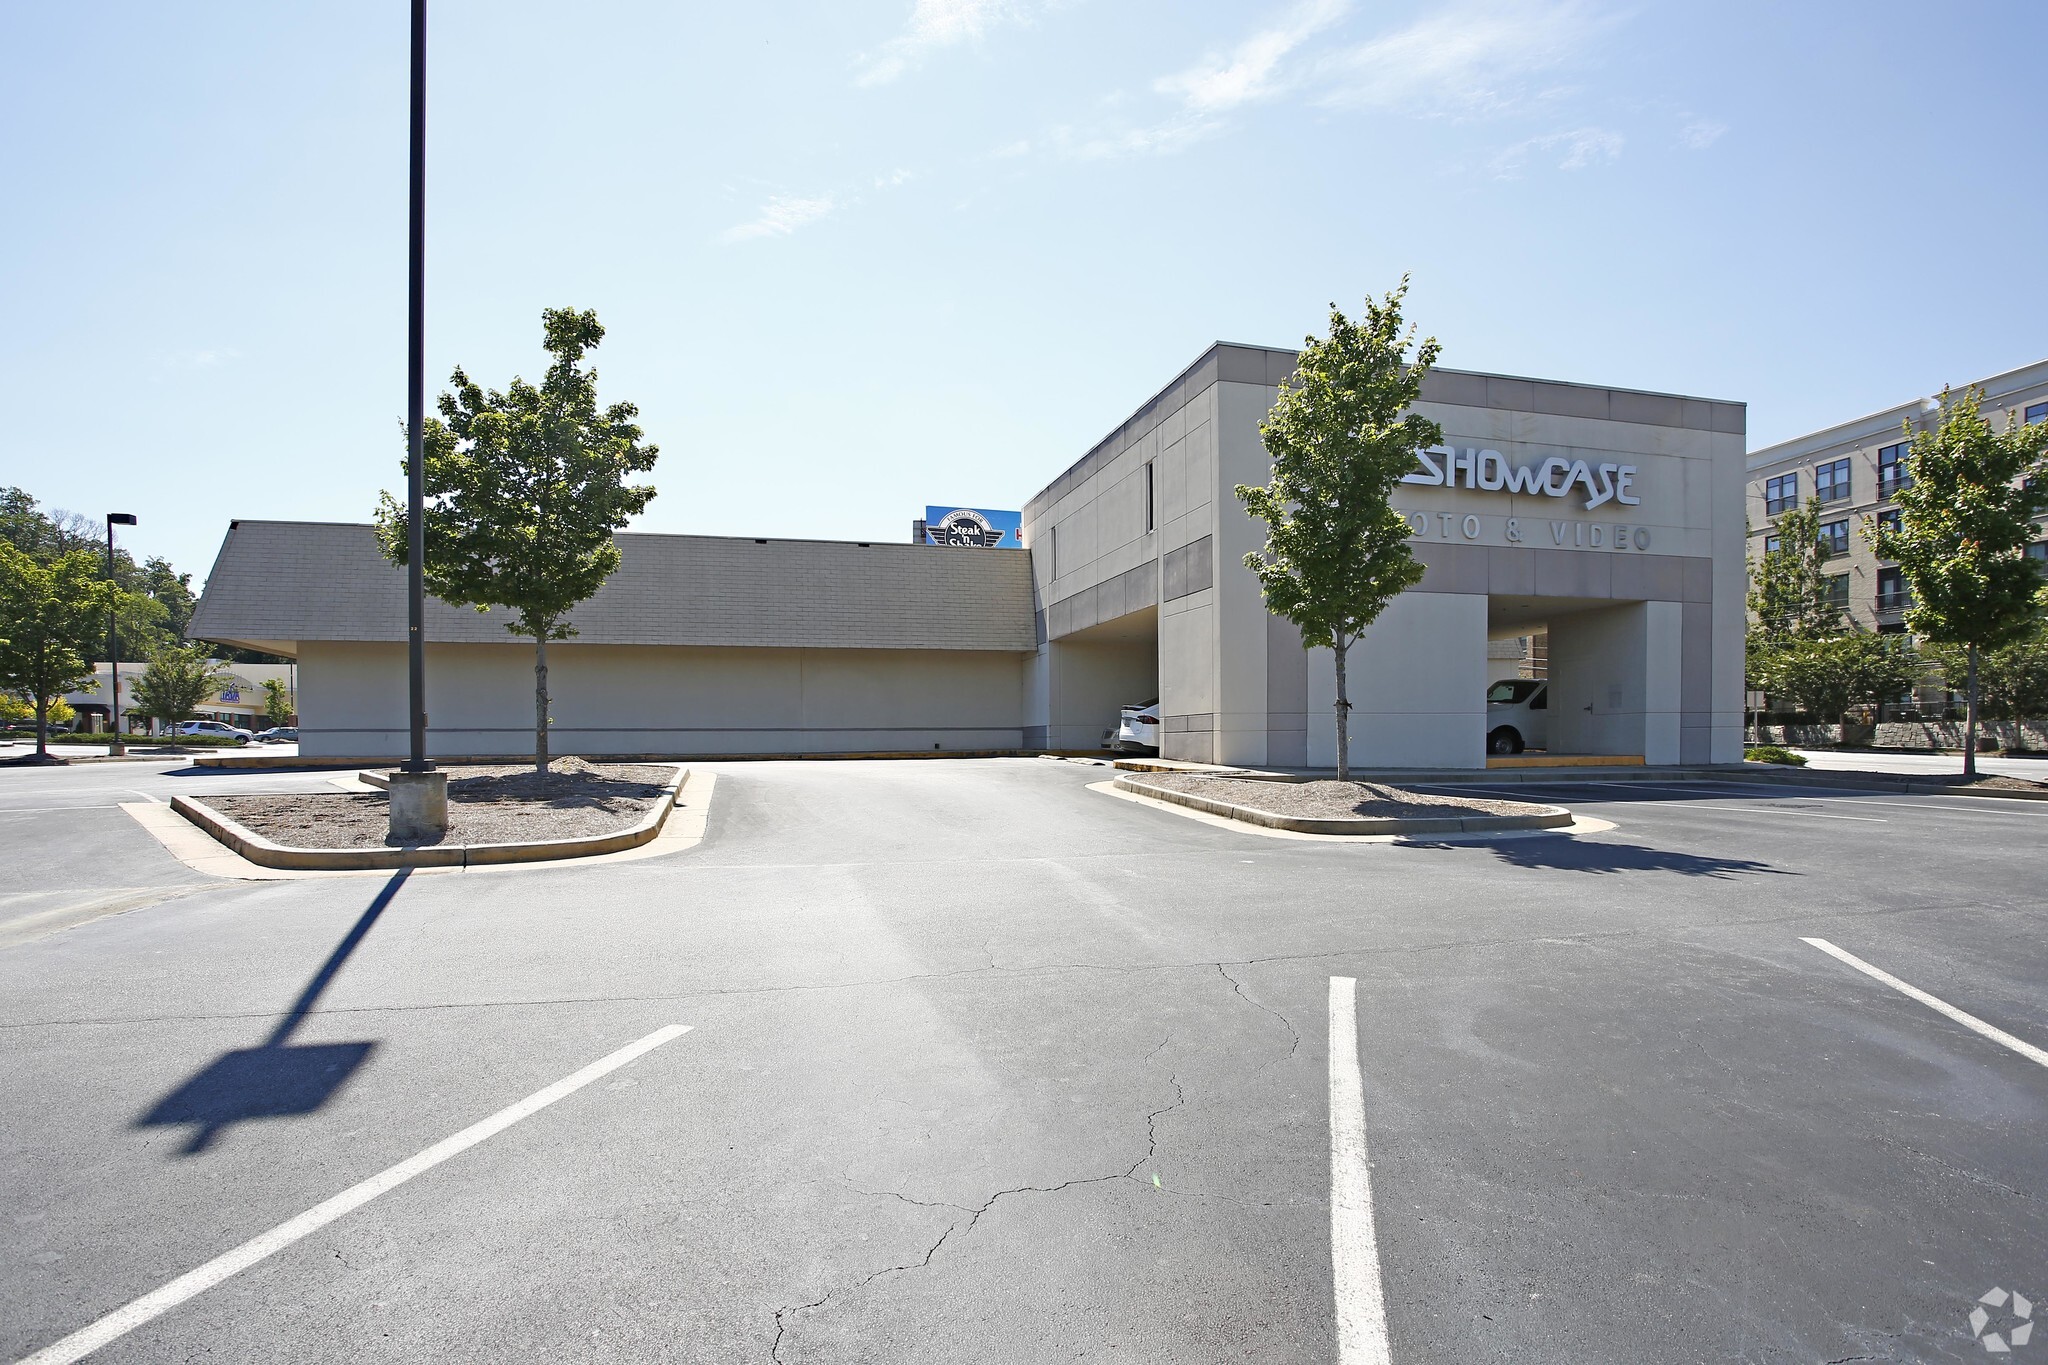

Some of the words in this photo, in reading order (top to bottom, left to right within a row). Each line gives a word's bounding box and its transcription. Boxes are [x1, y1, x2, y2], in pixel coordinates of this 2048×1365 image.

[1400, 445, 1640, 511] SHOWCASE
[950, 522, 981, 535] Steak
[1409, 512, 1481, 540] OTO
[1505, 517, 1523, 542] &
[1549, 521, 1651, 550] VIDEO
